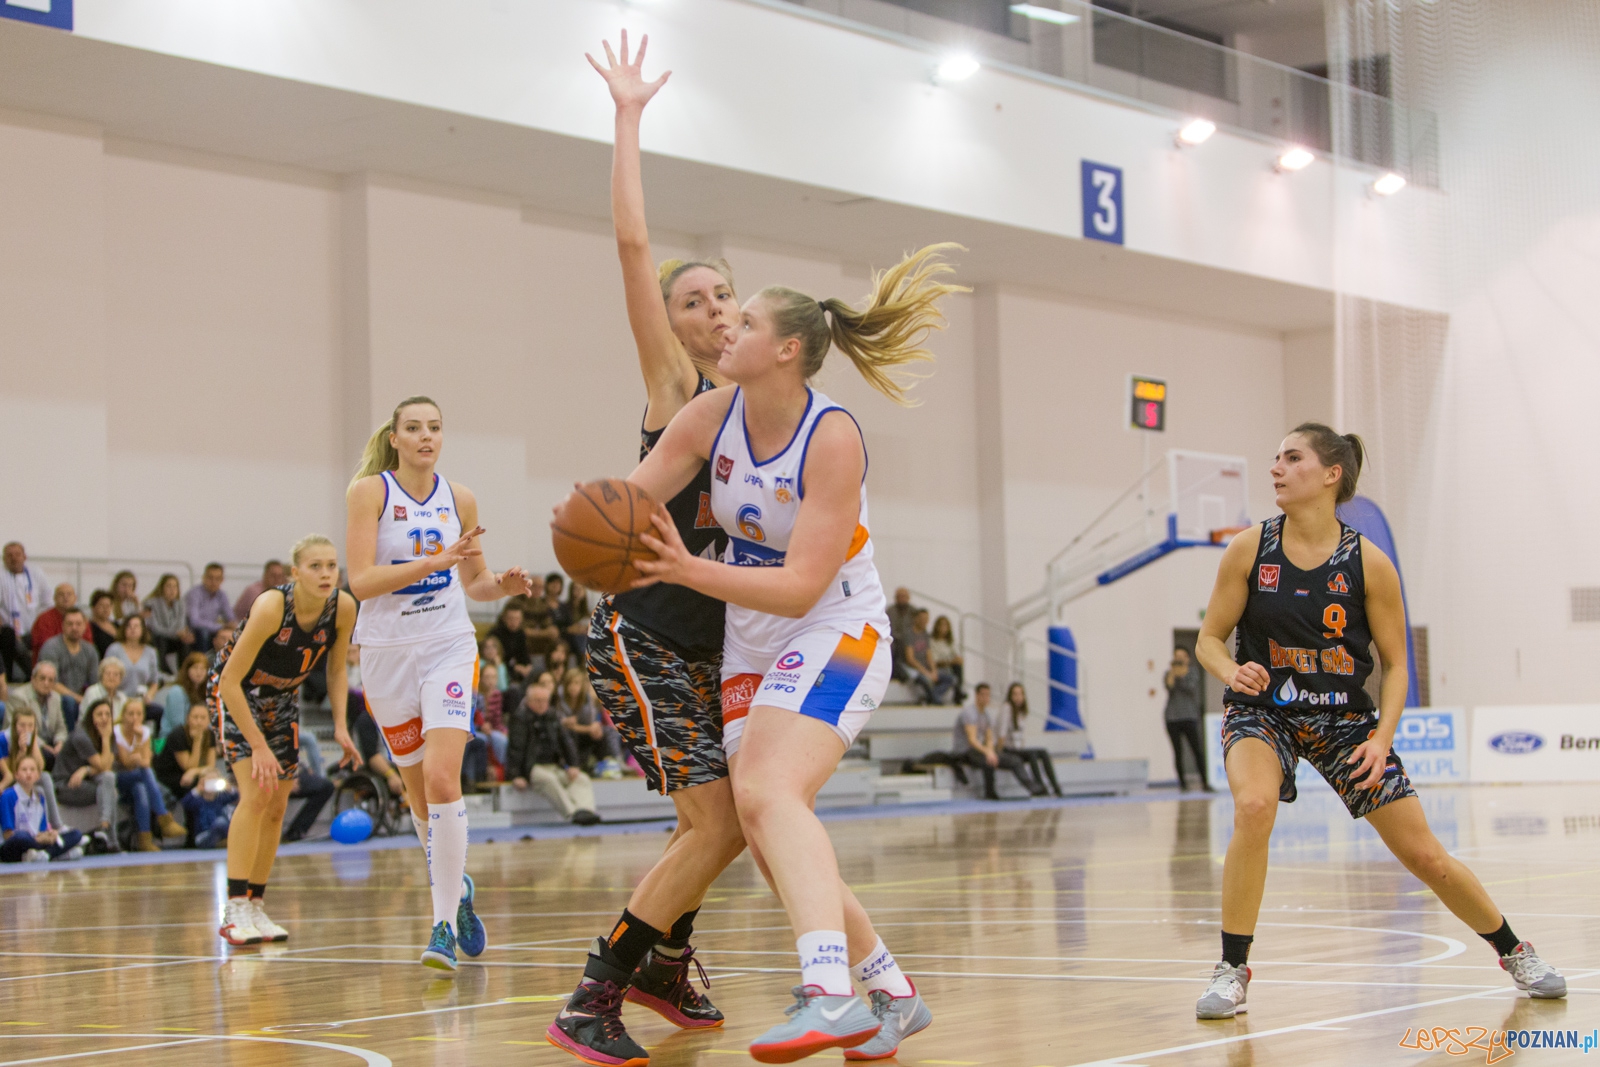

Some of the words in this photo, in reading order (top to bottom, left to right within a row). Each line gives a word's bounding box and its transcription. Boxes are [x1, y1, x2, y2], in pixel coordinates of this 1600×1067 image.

[1091, 169, 1118, 236] 3
[736, 503, 767, 543] 6
[407, 527, 446, 557] 13
[410, 574, 448, 587] nea
[422, 604, 446, 613] Motors
[1322, 602, 1347, 639] 9
[1298, 688, 1349, 706] PGKiM
[811, 956, 832, 965] AZS
[861, 969, 881, 982] AZS
